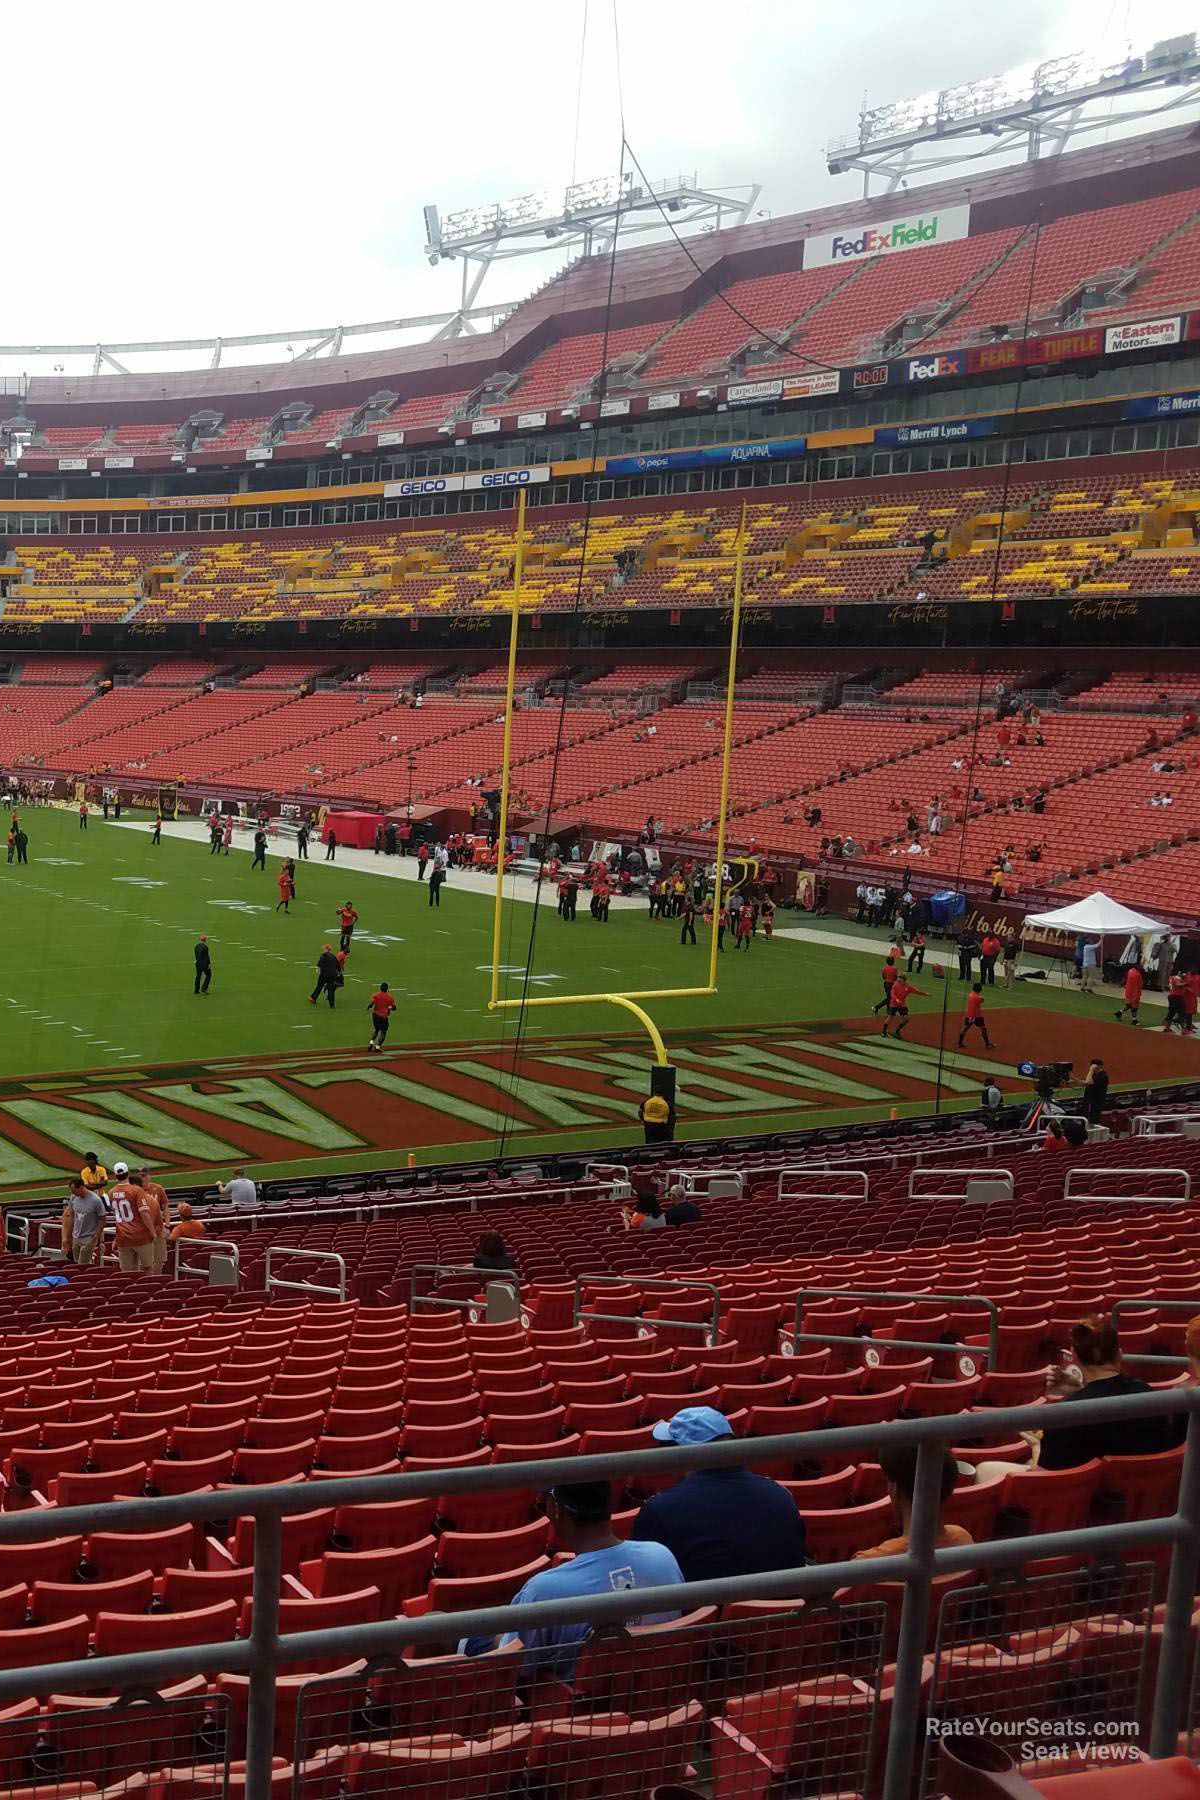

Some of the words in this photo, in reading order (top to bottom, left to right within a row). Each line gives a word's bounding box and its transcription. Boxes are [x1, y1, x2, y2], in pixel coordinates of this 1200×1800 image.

[832, 217, 937, 258] FedExField
[1112, 330, 1121, 339] At
[1122, 323, 1175, 339] Eastern
[980, 348, 1016, 367] FEAR
[1043, 334, 1098, 357] TURTLE
[909, 356, 958, 380] FedEx
[730, 383, 772, 397] Carpetland
[910, 426, 938, 440] Merrill
[941, 423, 967, 436] Lynch
[646, 456, 669, 468] pepsi
[731, 446, 771, 461] AQUAFINA
[400, 479, 446, 495] GEICO
[481, 470, 530, 487] GEICO
[977, 916, 990, 934] to
[994, 916, 1016, 938] the
[112, 1200, 134, 1223] 10
